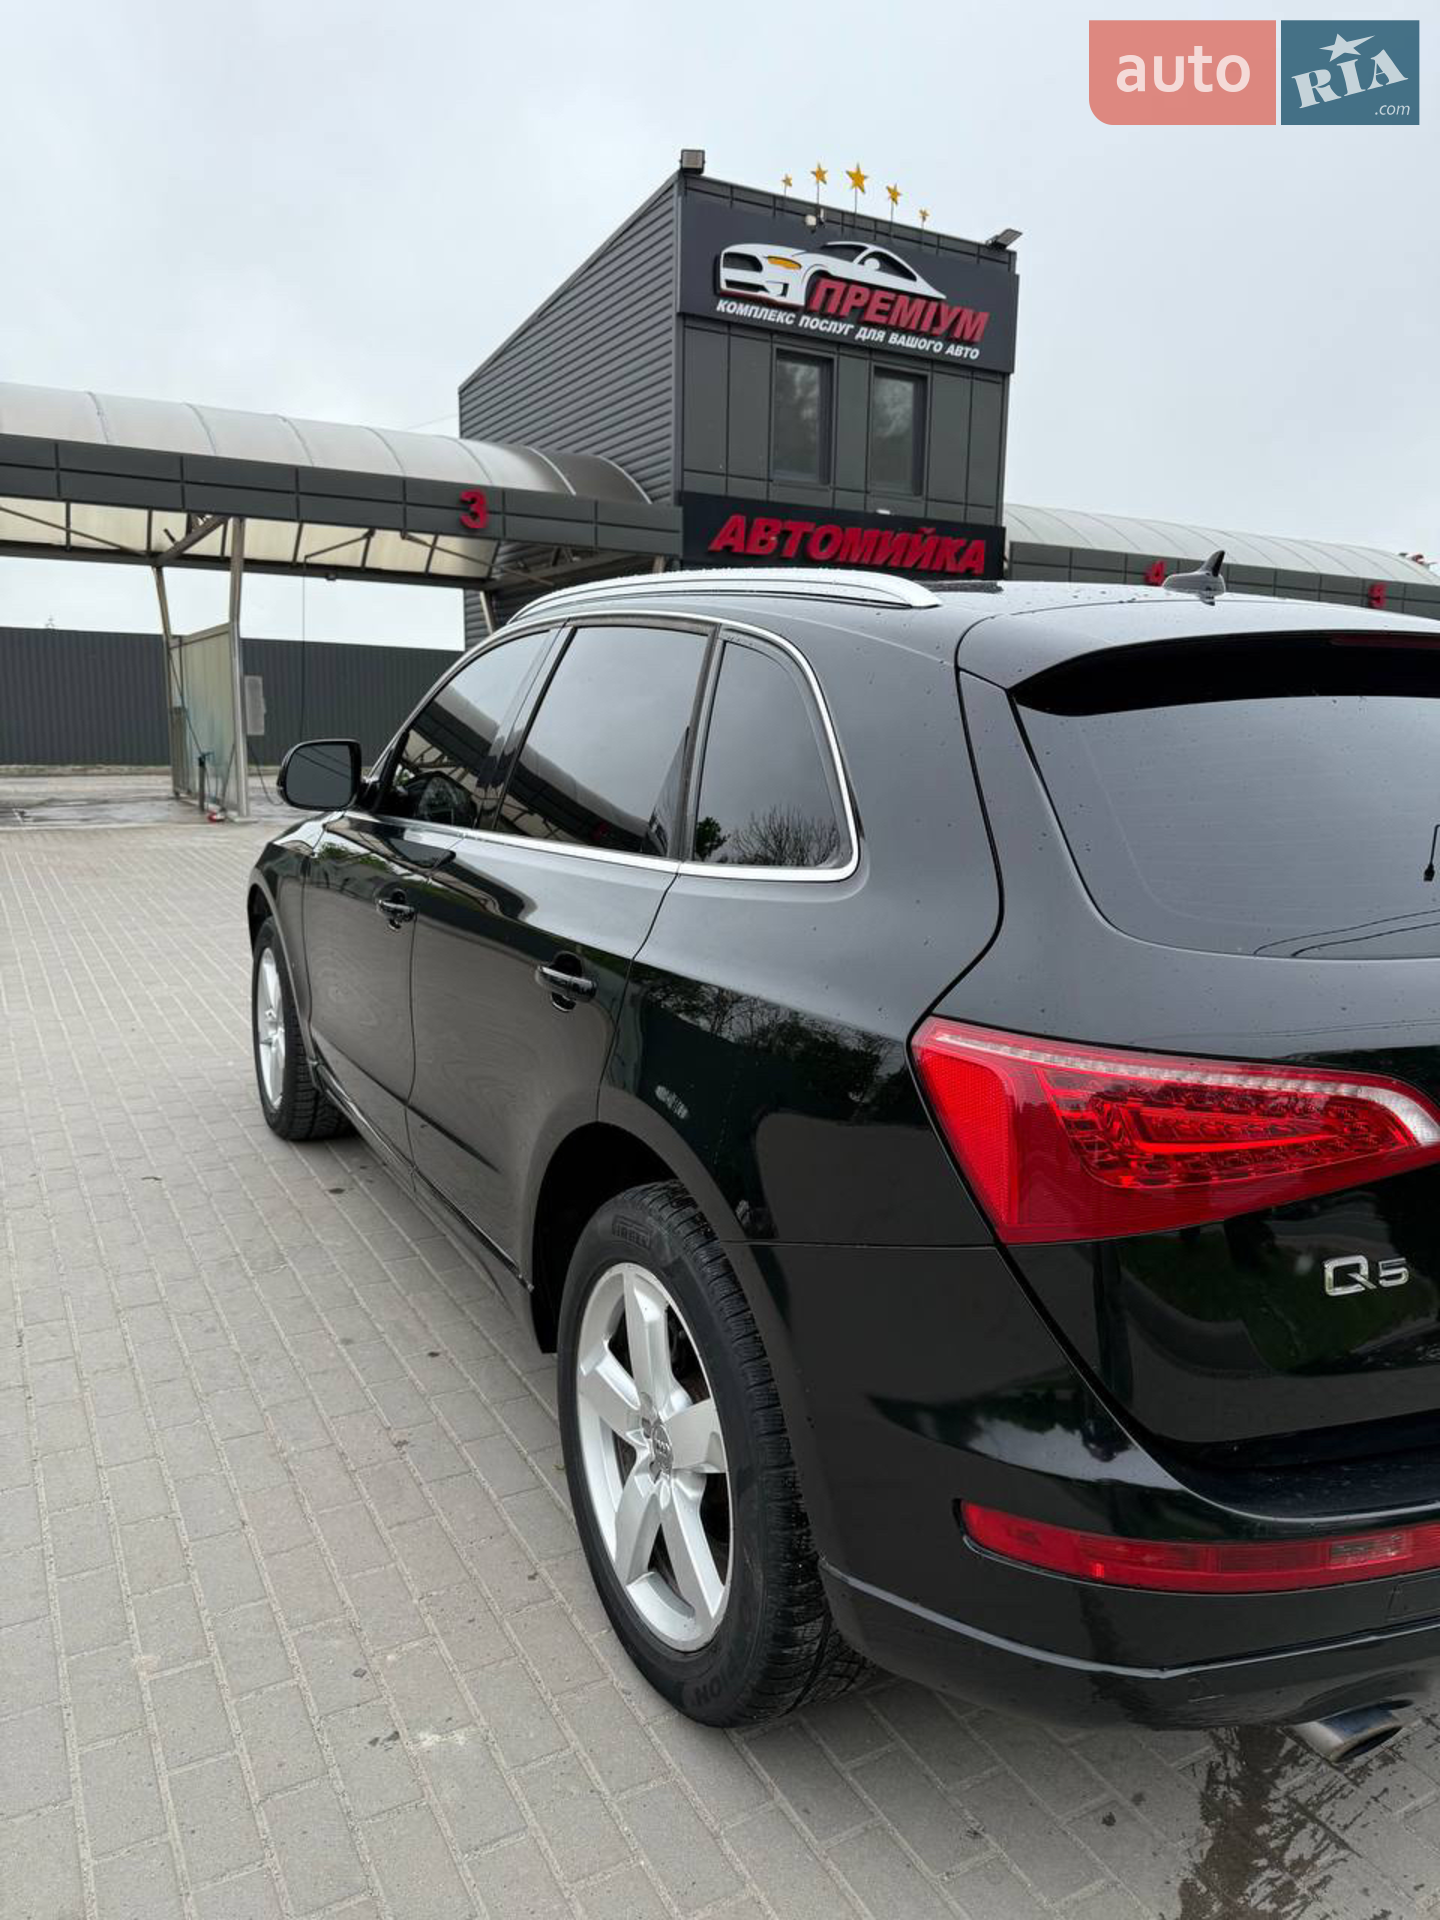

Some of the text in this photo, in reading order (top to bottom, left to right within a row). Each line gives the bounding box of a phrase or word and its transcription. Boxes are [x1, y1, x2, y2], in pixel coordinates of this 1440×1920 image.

[716, 299, 980, 360] КОМПЛЕКС ПОСЛУГ ДЛЯ ВАШОГО АВТО
[808, 278, 990, 342] ПРЕМІУМ
[459, 489, 488, 529] 3
[708, 514, 986, 575] АВТОМИЙКА
[1324, 1255, 1409, 1296] Q5
